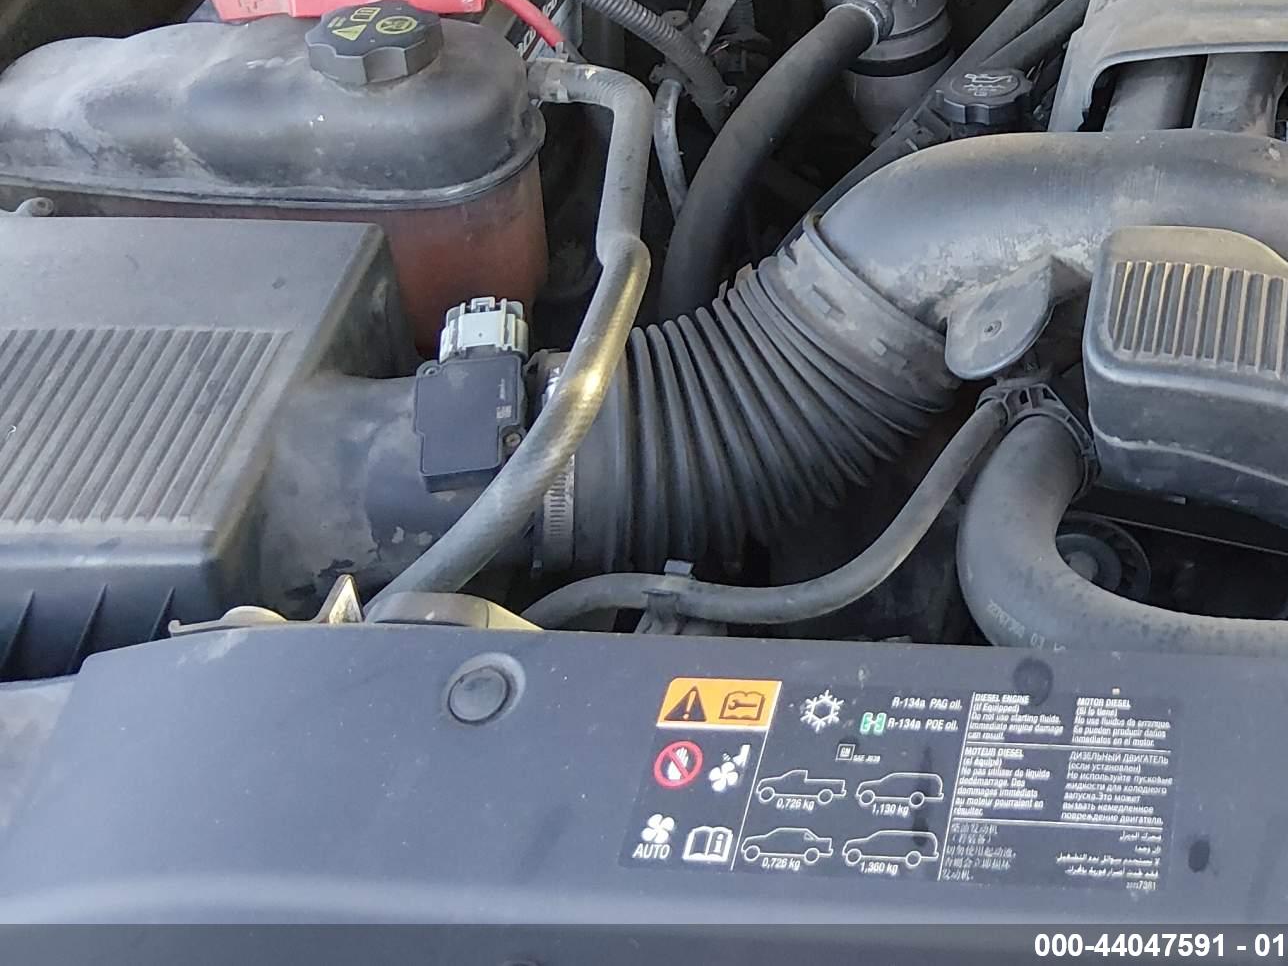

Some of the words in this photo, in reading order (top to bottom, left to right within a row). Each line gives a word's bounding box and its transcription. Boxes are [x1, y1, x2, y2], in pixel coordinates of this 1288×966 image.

[892, 697, 926, 709] R-134a
[929, 698, 948, 710] PAG
[949, 698, 963, 710] oil.
[975, 693, 1000, 702] DIESEL
[1002, 694, 1030, 704] ENGINE
[1077, 698, 1105, 707] MOTOR
[1105, 699, 1131, 709] DIESEL
[982, 703, 1019, 714] Equipped)
[972, 712, 981, 720] Do
[982, 712, 994, 721] not
[1010, 714, 1038, 723] starting
[1074, 716, 1084, 724] No
[1086, 717, 1099, 725] use
[887, 718, 921, 730] R-134a
[925, 719, 944, 731] POE
[945, 720, 959, 731] oil.
[1008, 724, 1033, 733] engine
[1034, 724, 1064, 735] damage
[965, 747, 996, 756] MOTEUR
[997, 748, 1024, 758] DIESEL
[973, 768, 986, 777] pas
[803, 799, 815, 811] kg
[897, 805, 909, 817] kg
[632, 843, 670, 859] AUTO
[789, 859, 801, 871] kg
[886, 863, 899, 875] kg
